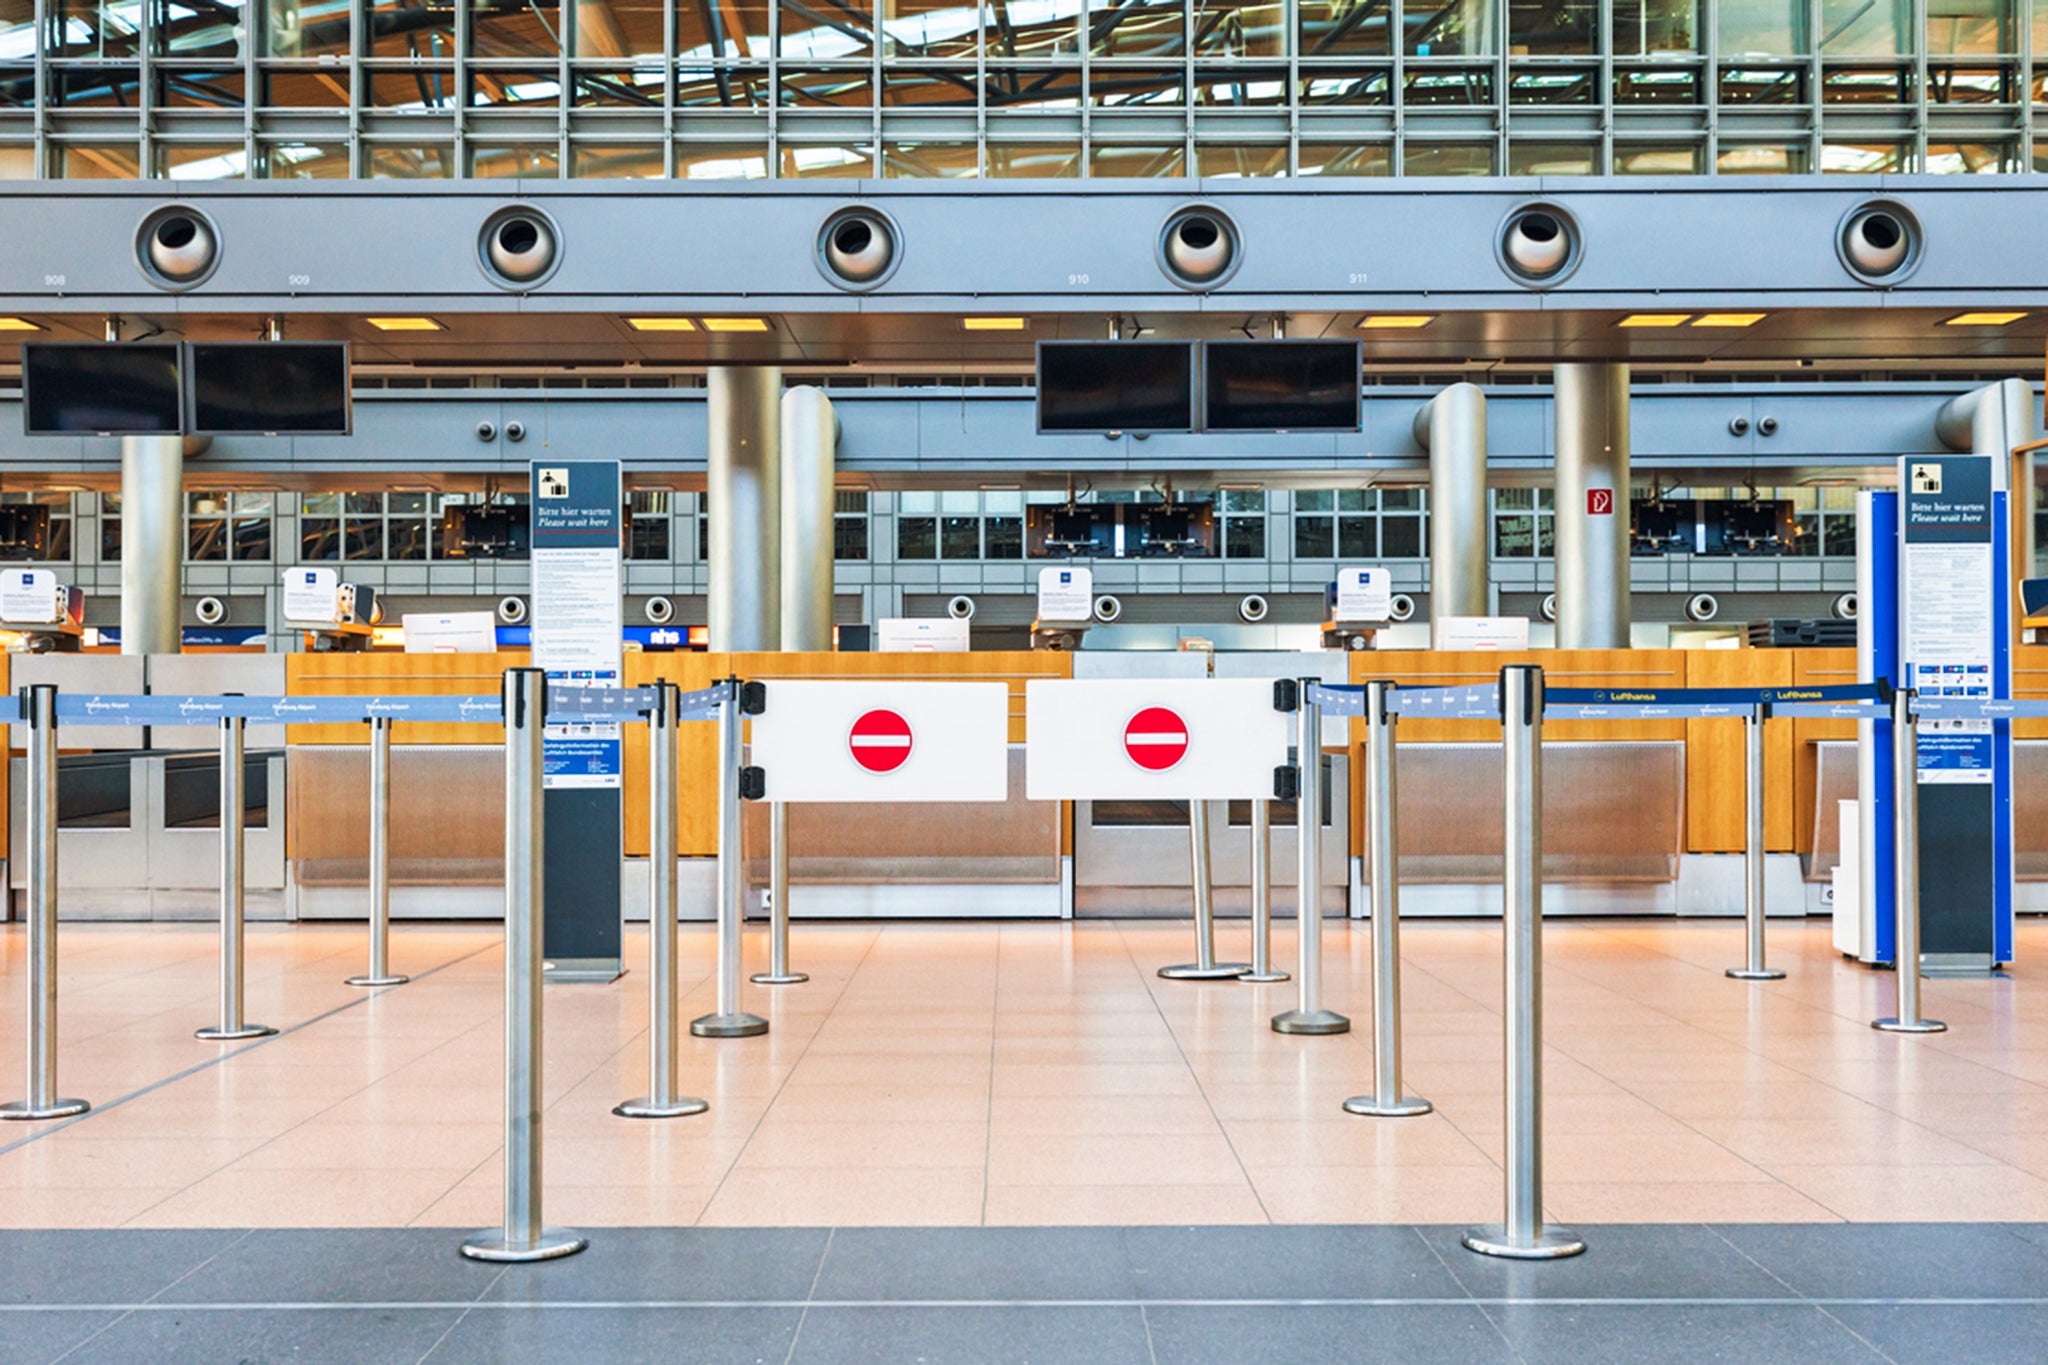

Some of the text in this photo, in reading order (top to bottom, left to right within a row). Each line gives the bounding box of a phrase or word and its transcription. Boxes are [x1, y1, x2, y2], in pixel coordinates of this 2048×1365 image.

[288, 274, 310, 286] 909
[1068, 273, 1089, 285] 910
[1349, 273, 1367, 284] 911
[538, 506, 612, 516] Bitte hier warten
[1911, 502, 1985, 512] Bitte hier warten
[538, 517, 609, 527] Please wait here
[1911, 513, 1982, 522] Please wait here
[650, 628, 680, 644] ahs
[1610, 692, 1656, 701] Lufthansa
[1777, 691, 1823, 700] Lufthansa
